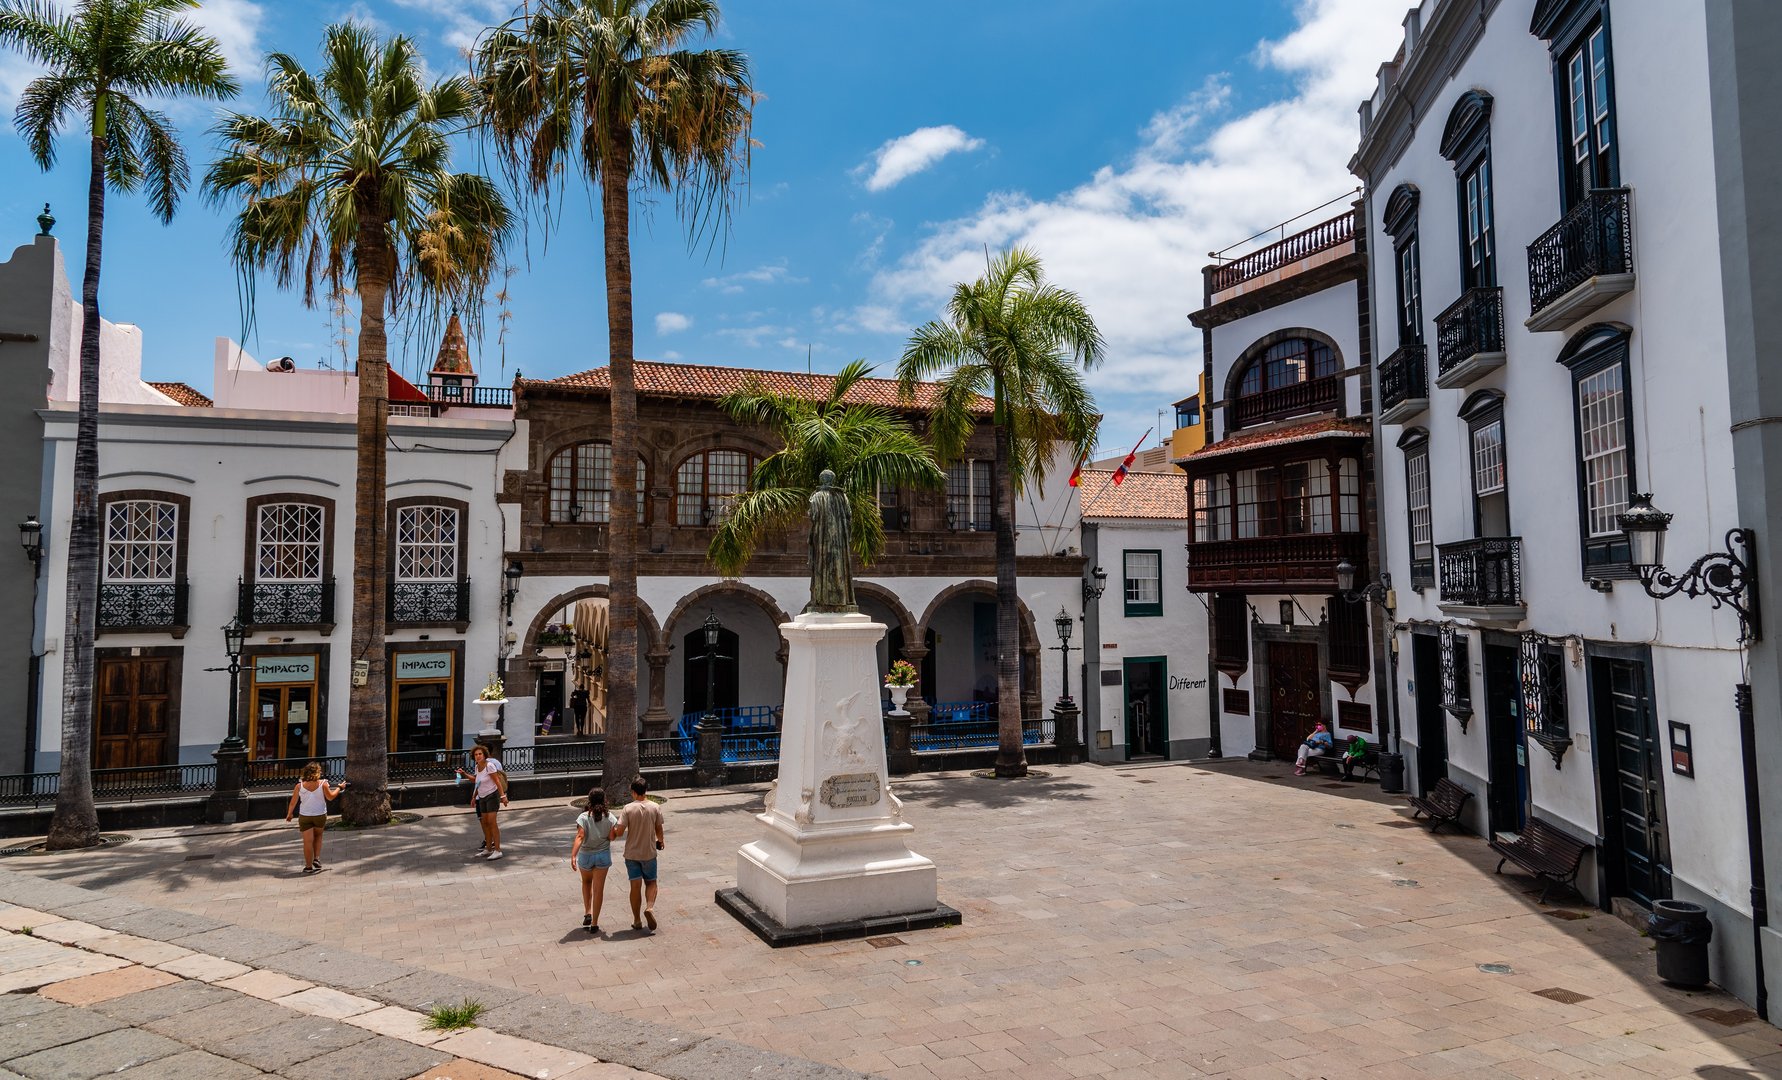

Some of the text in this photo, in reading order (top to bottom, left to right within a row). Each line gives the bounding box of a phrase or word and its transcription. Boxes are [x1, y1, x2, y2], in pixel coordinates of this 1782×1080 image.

[262, 664, 310, 674] IMPACTO
[402, 660, 446, 670] IMPACTO
[1169, 675, 1207, 690] Different
